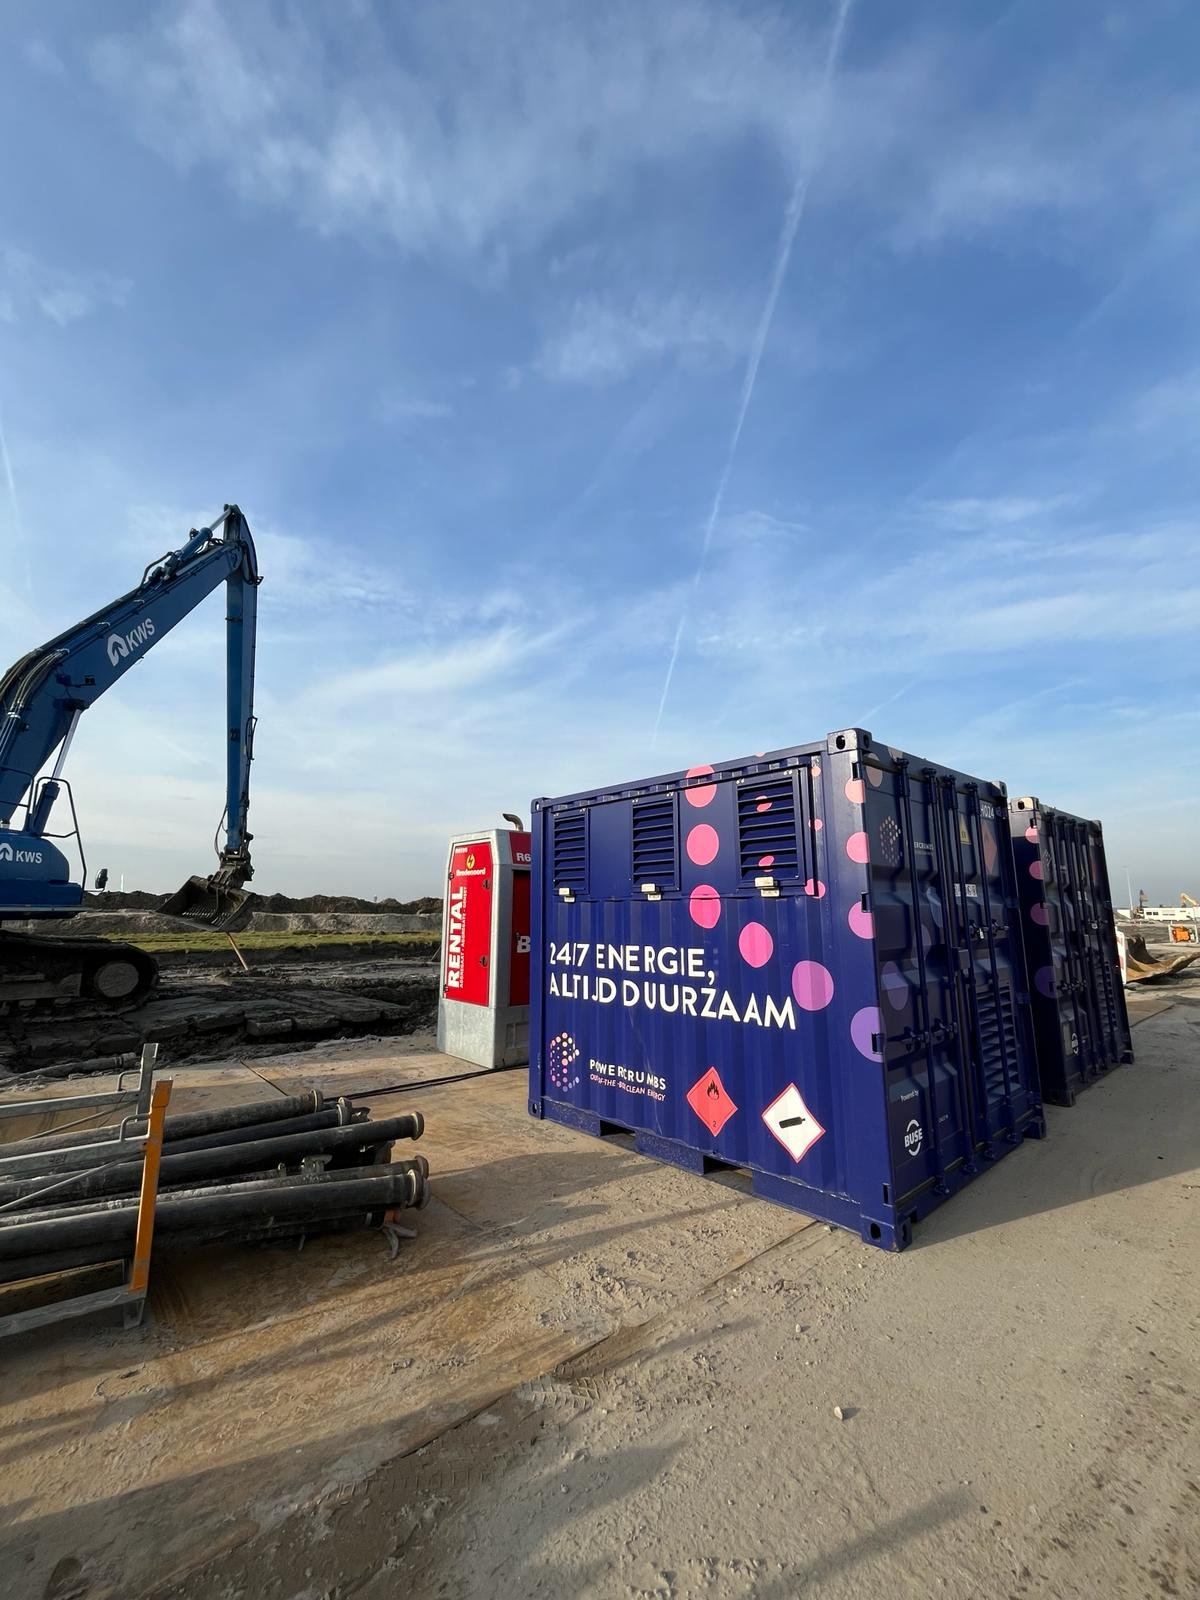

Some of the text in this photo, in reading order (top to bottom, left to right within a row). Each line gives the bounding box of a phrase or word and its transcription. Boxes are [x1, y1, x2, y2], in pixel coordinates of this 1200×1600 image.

[126, 618, 155, 651] KWS
[16, 850, 42, 864] KWS
[447, 886, 463, 989] RENTAL
[596, 944, 715, 985] ENERGIE,
[550, 972, 796, 1030] ALTIJD DUURZAAM
[904, 1128, 923, 1148] BUSE
